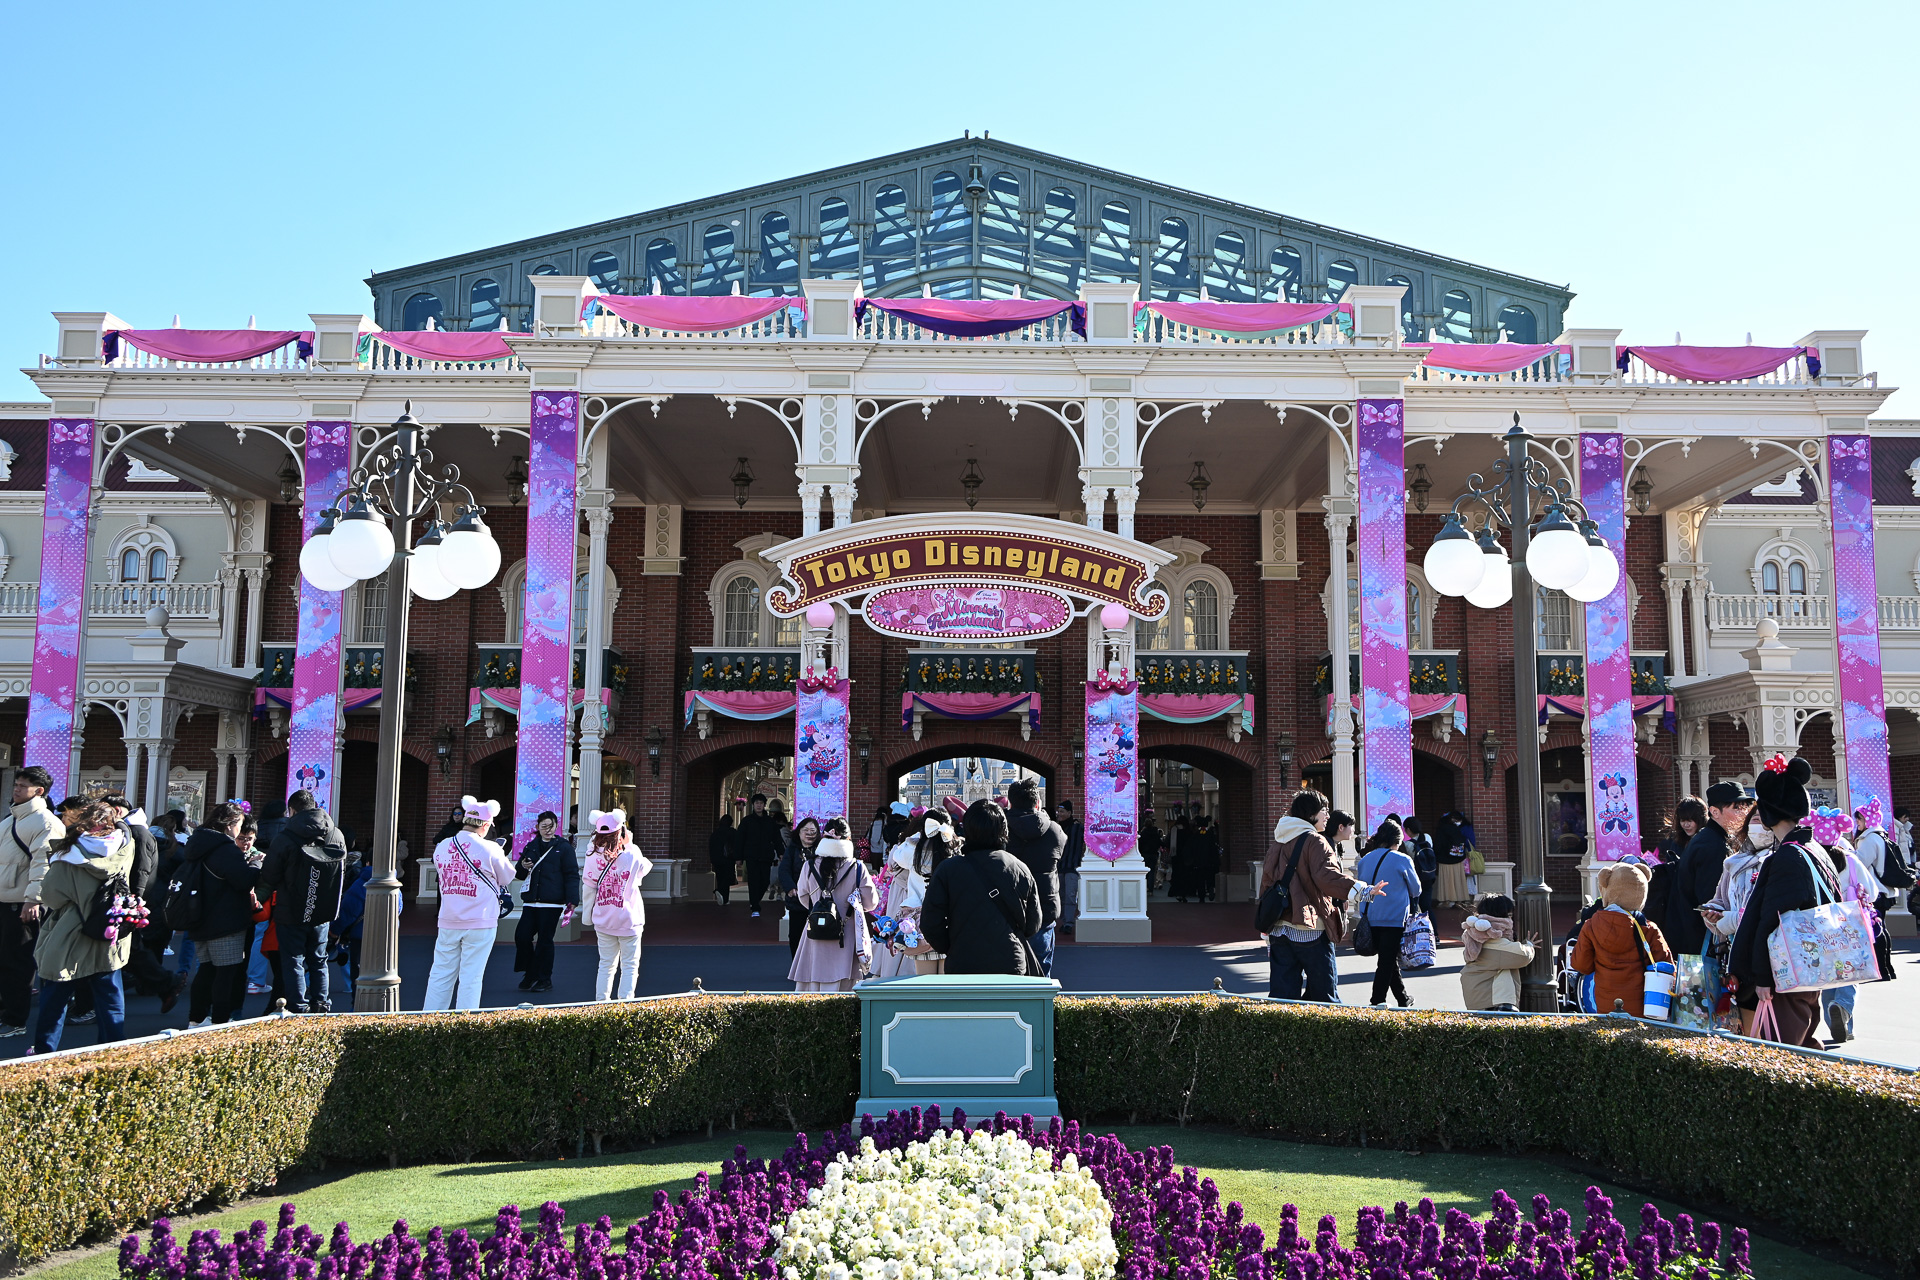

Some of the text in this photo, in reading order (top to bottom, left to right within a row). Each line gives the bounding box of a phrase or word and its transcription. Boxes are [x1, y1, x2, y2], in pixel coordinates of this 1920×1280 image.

[804, 539, 1127, 591] Tokyo Disneyland
[941, 598, 1000, 619] Minnie's
[302, 865, 321, 923] Dickies
